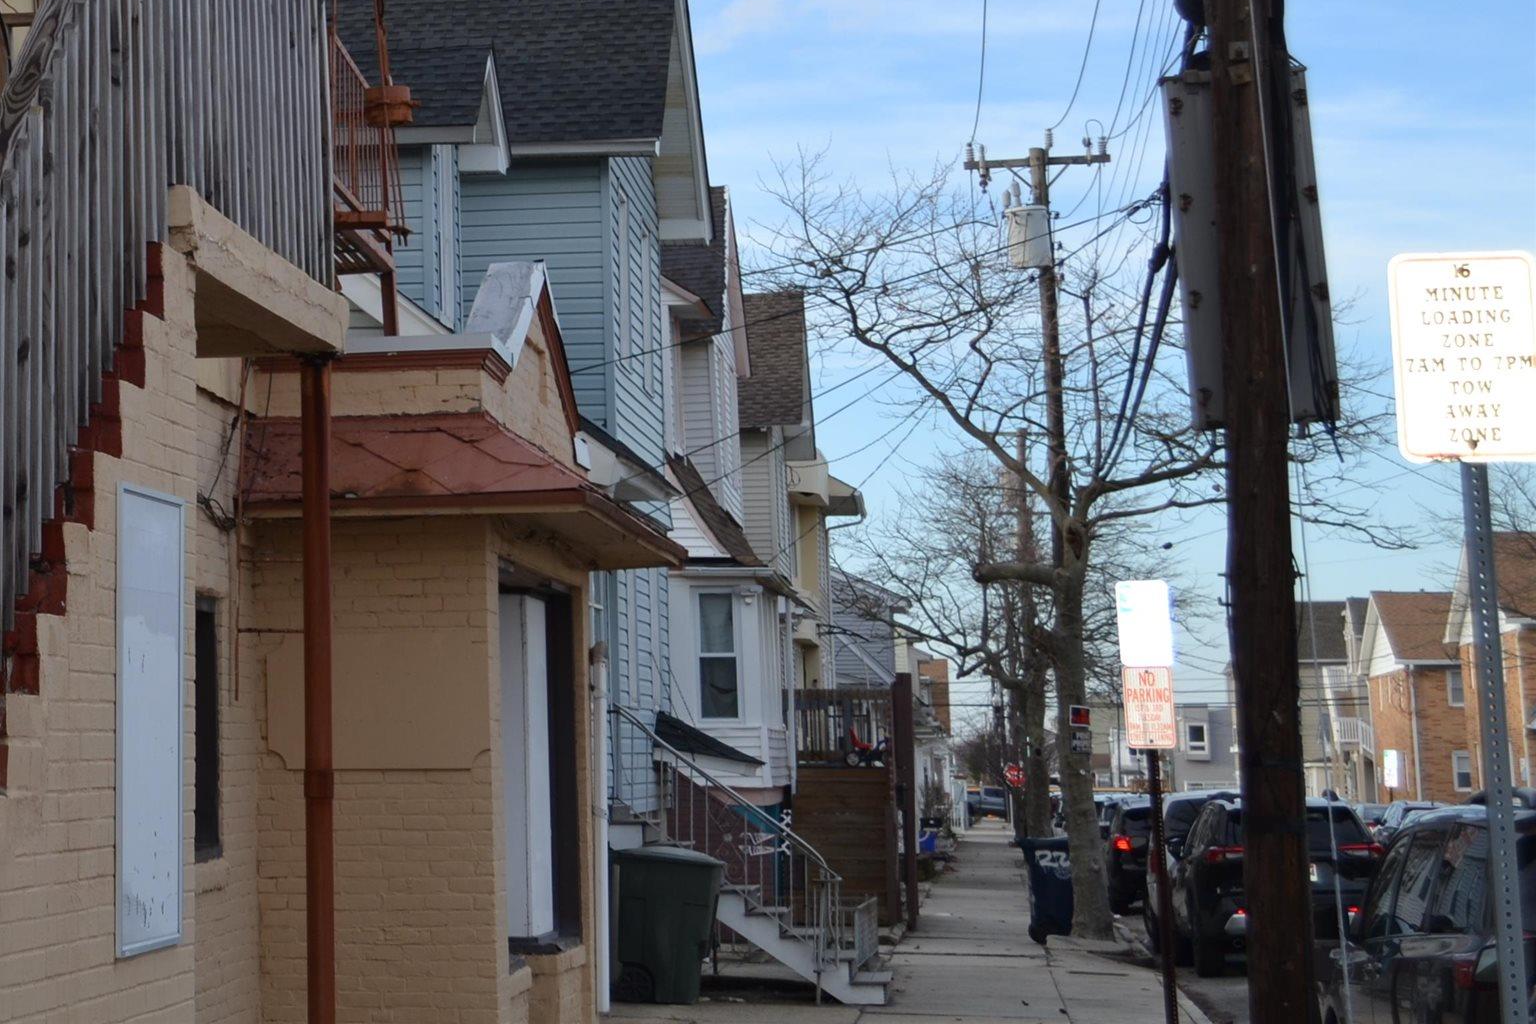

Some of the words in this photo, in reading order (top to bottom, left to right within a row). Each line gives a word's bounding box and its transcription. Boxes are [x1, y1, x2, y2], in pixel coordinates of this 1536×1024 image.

[1425, 285, 1505, 302] MINUTE
[1421, 309, 1512, 326] LOADING
[1441, 333, 1494, 348] ZONE
[1405, 357, 1446, 373] 7AM
[1458, 357, 1482, 371] TO
[1495, 355, 1533, 369] 7PM
[1449, 380, 1493, 395] TOW
[1446, 403, 1501, 419] AWAY
[1449, 427, 1502, 442] ZONE
[1138, 672, 1155, 687] NO
[1126, 688, 1170, 703] PARKING
